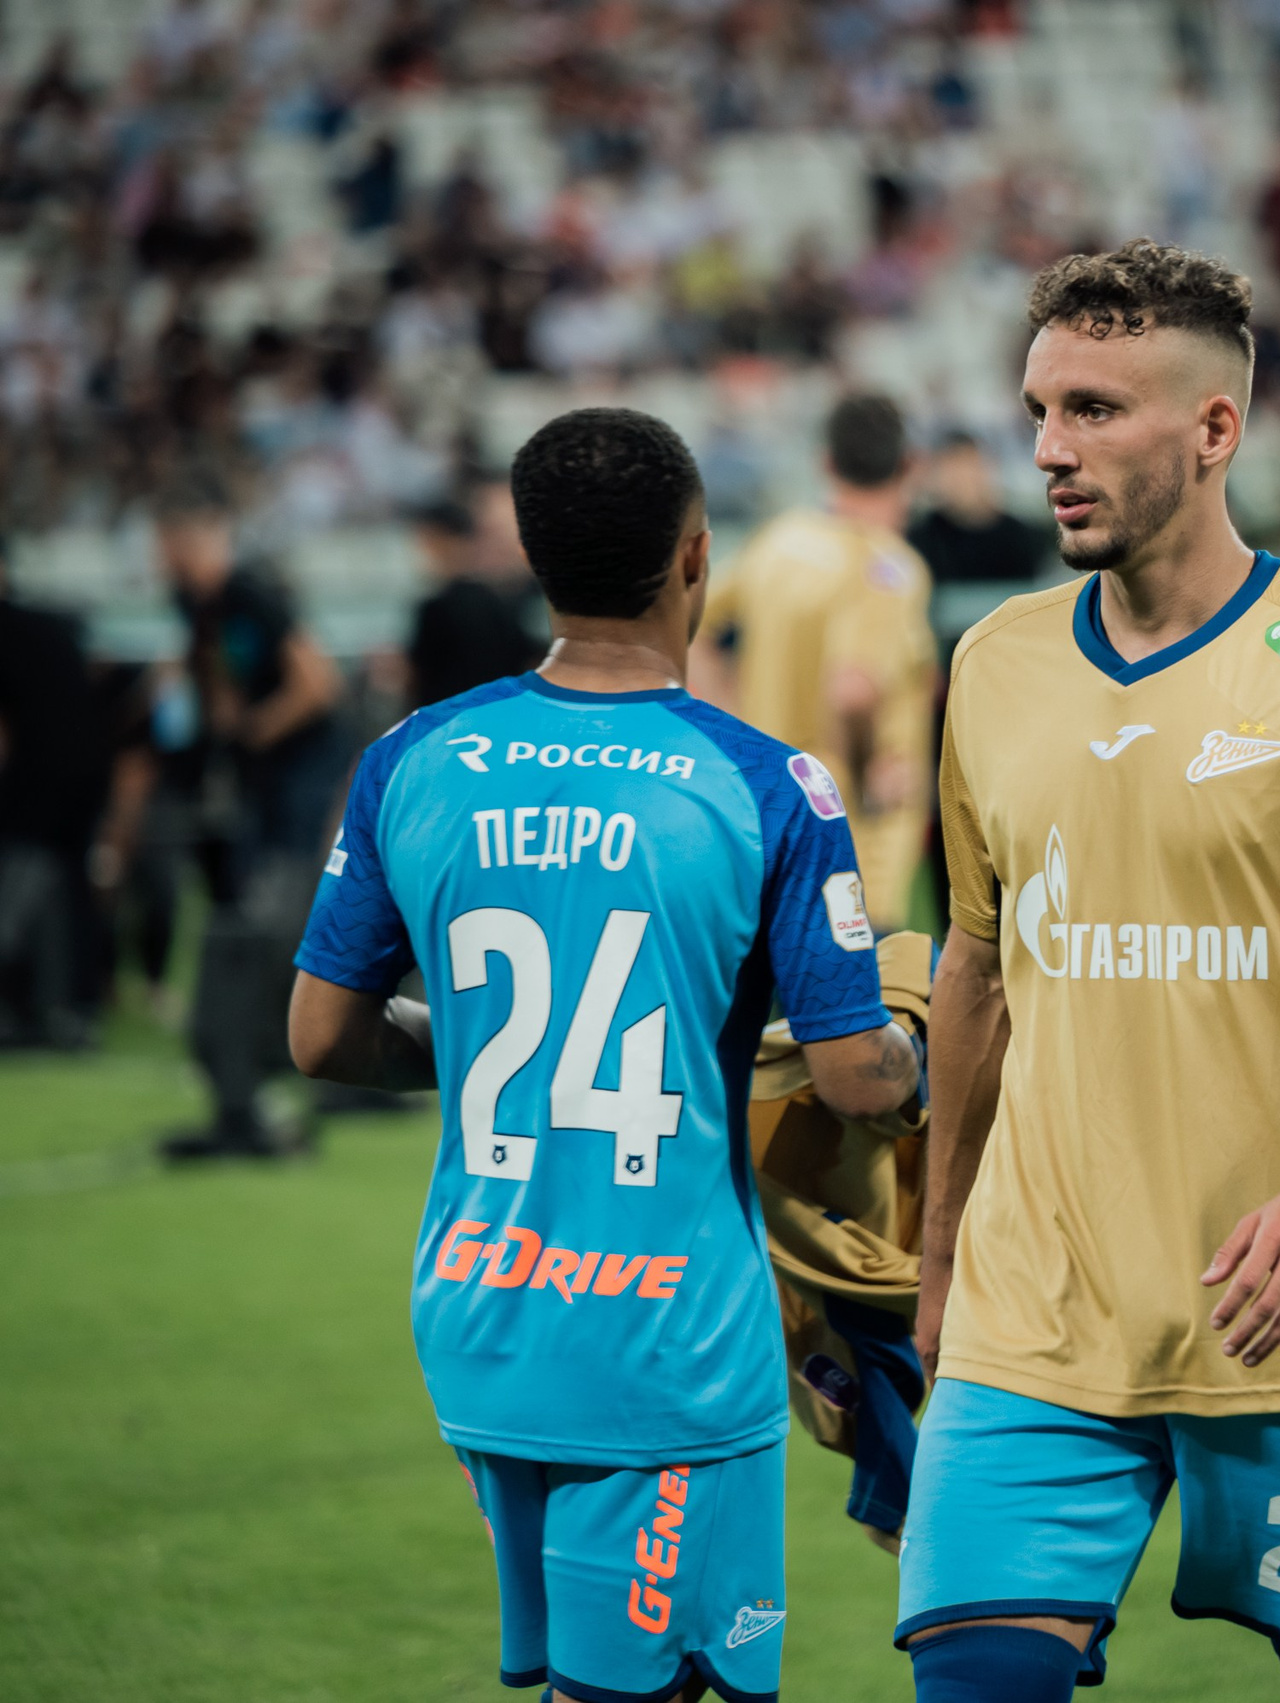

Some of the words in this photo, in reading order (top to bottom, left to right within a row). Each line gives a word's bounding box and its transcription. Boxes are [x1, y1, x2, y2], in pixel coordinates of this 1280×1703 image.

[506, 741, 696, 779] РОССИЯ
[472, 806, 636, 872] ПЕДРО
[1070, 922, 1269, 981] ГАЗПРОМ
[448, 906, 683, 1187] 24
